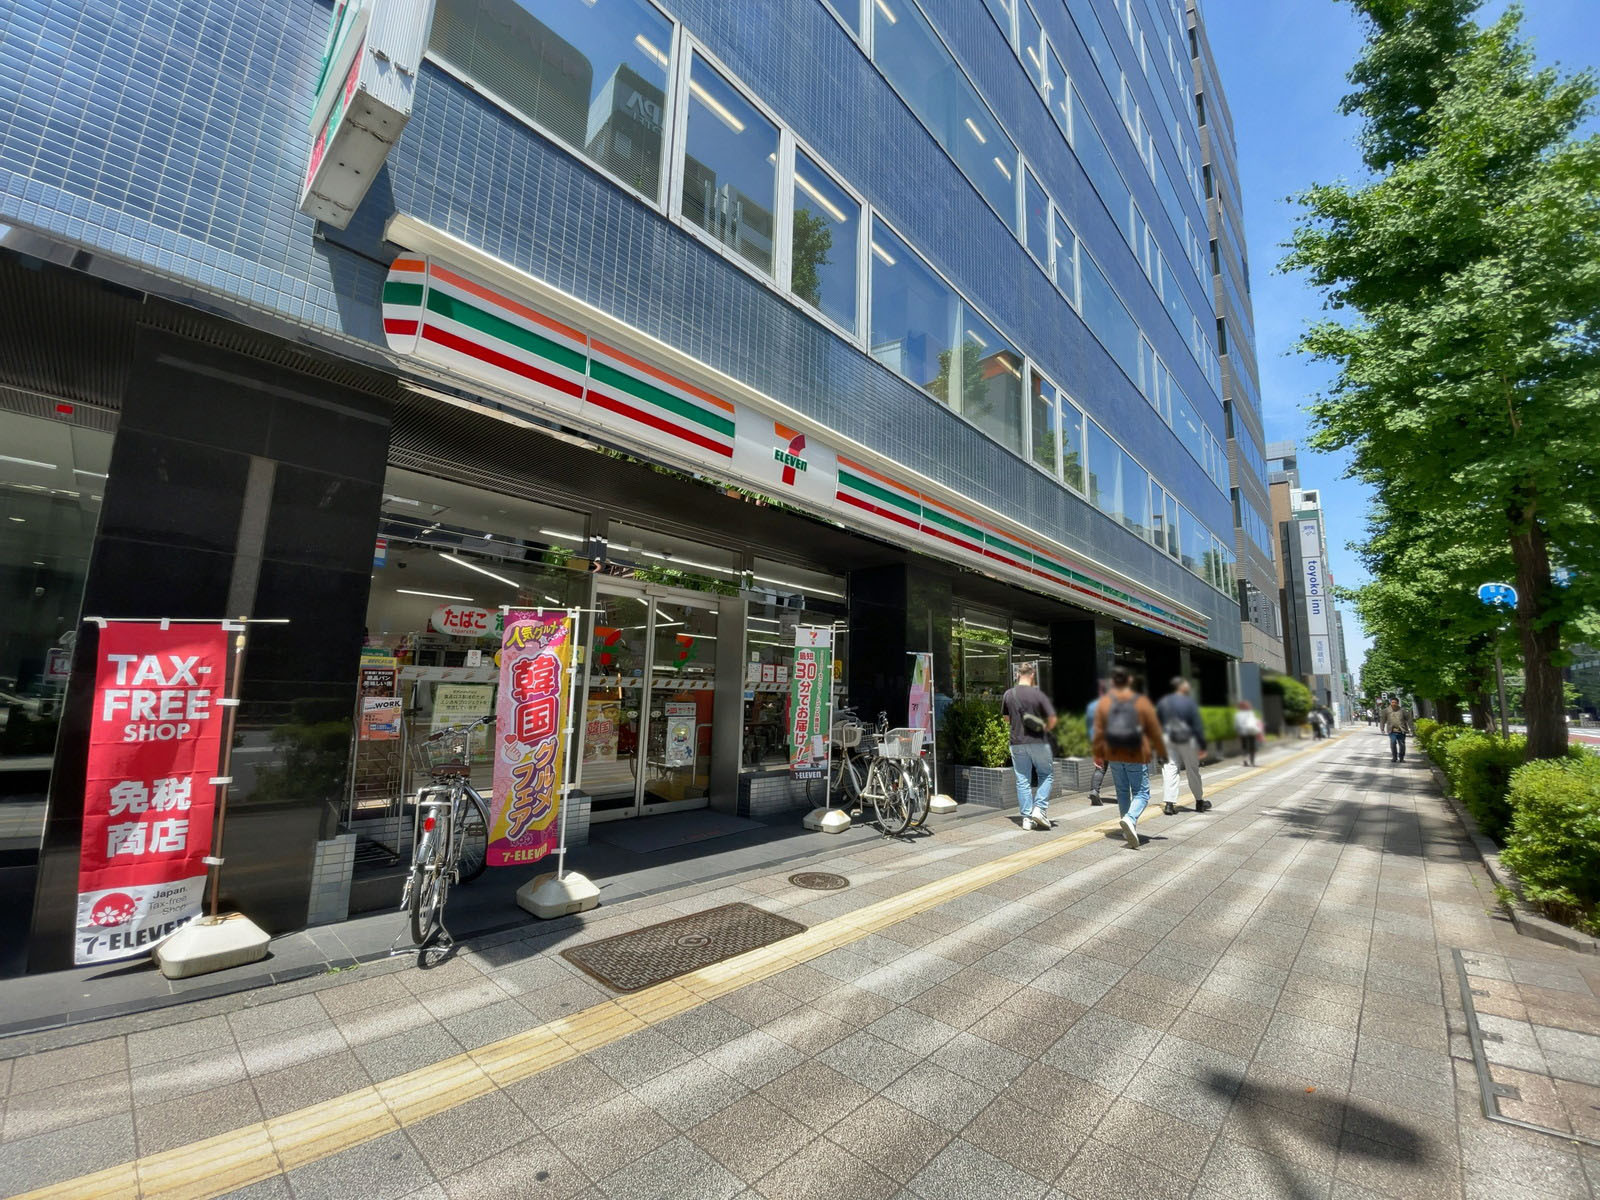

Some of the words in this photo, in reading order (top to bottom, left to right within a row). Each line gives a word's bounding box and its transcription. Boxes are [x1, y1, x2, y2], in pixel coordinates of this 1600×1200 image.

[1307, 560, 1319, 597] toyoko
[443, 608, 487, 629] たばこ
[1312, 599, 1321, 615] inn
[107, 654, 212, 686] TAX-
[103, 689, 211, 721] FREE
[375, 700, 401, 709] WORK
[513, 656, 556, 743] 韓国
[123, 723, 191, 742] SHOP
[533, 738, 556, 815] グルメ
[108, 777, 192, 817] 免税
[508, 763, 535, 836] フェア
[106, 818, 189, 858] 商店
[149, 895, 188, 912] Tax-free
